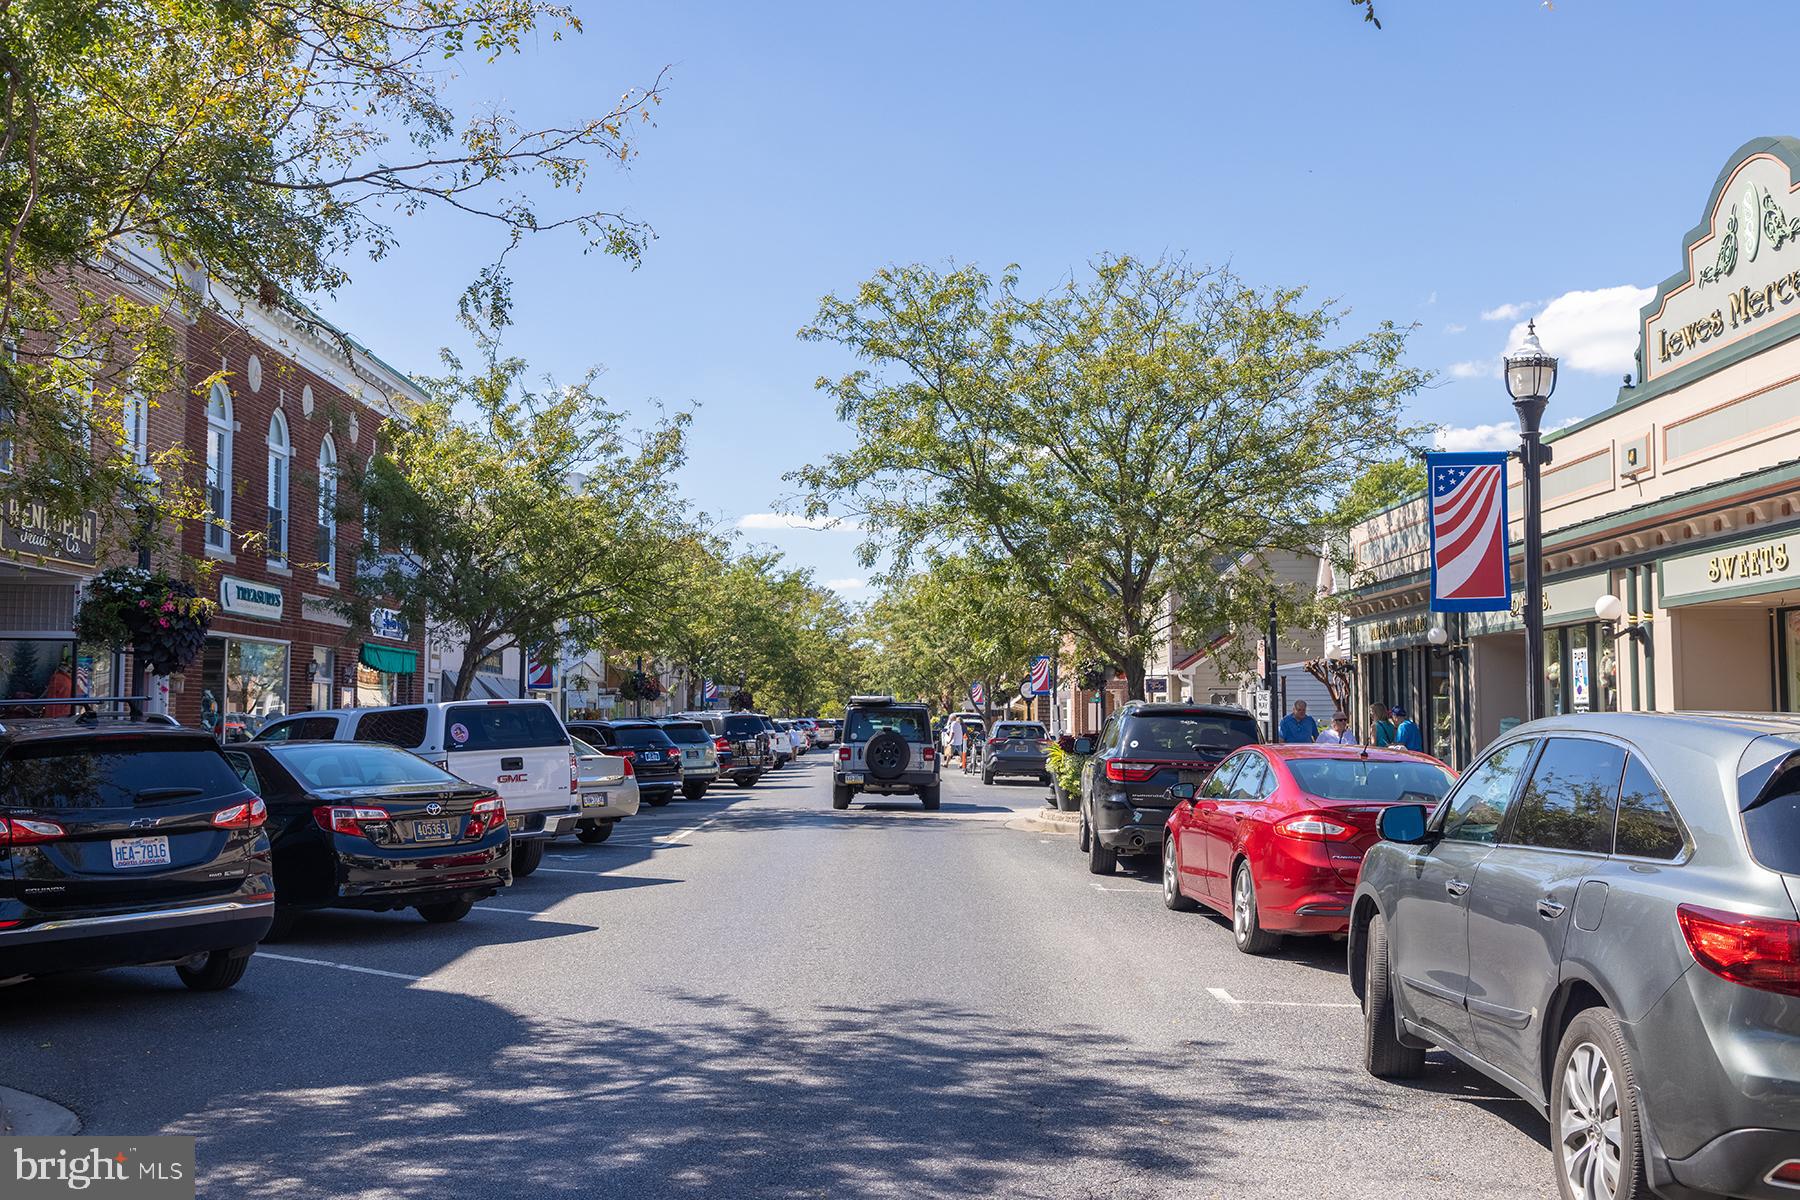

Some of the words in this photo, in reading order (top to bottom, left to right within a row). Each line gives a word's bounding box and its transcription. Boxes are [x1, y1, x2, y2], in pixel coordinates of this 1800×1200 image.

[1658, 309, 1725, 363] Lewes
[1708, 543, 1790, 583] SWEETS
[235, 585, 281, 607] TREASURES
[1258, 693, 1268, 701] ONE
[497, 774, 528, 784] GMC
[417, 823, 447, 836] 405363
[115, 843, 167, 861] HEA-7816
